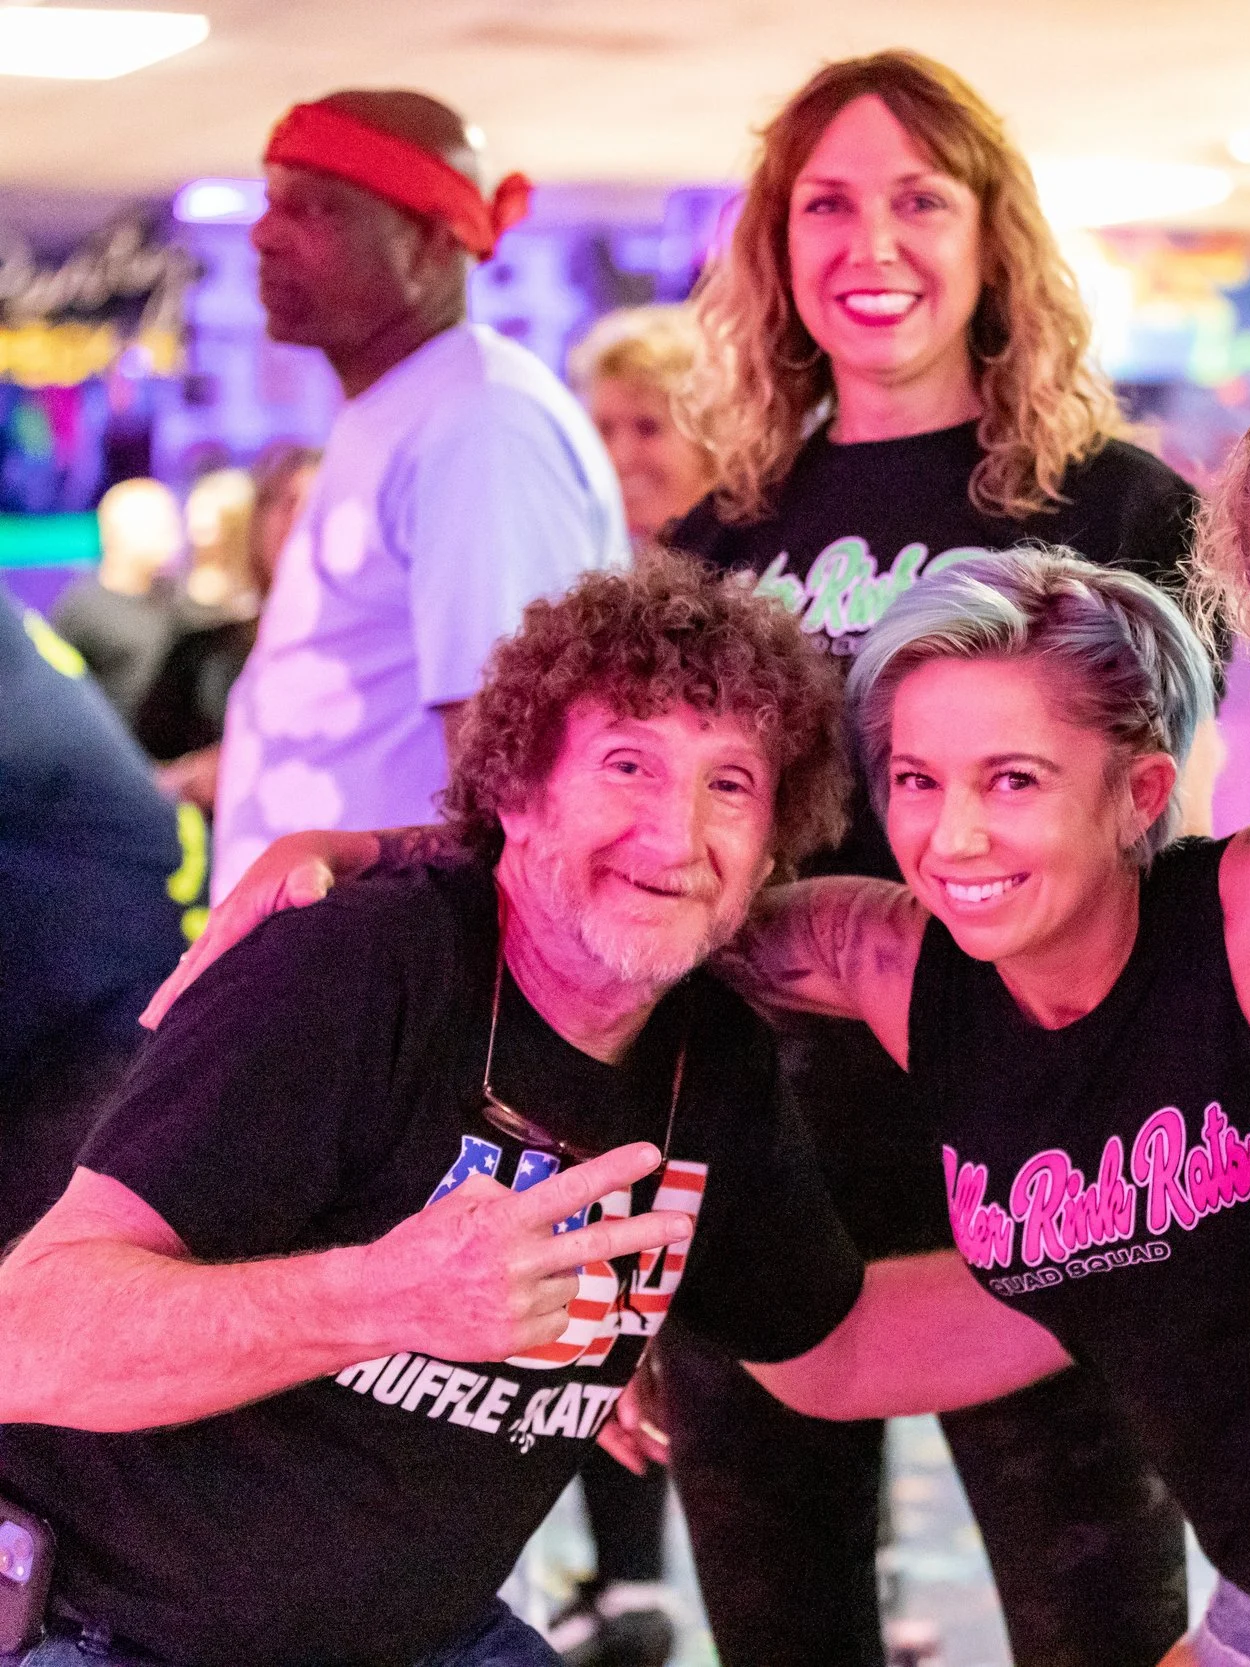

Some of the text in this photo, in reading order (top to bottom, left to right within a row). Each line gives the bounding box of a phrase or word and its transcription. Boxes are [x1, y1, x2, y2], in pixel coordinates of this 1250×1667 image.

[1009, 1149, 1136, 1268] Rink
[1065, 1241, 1171, 1279] SQUAD
[334, 1351, 520, 1434] HUFFLE
